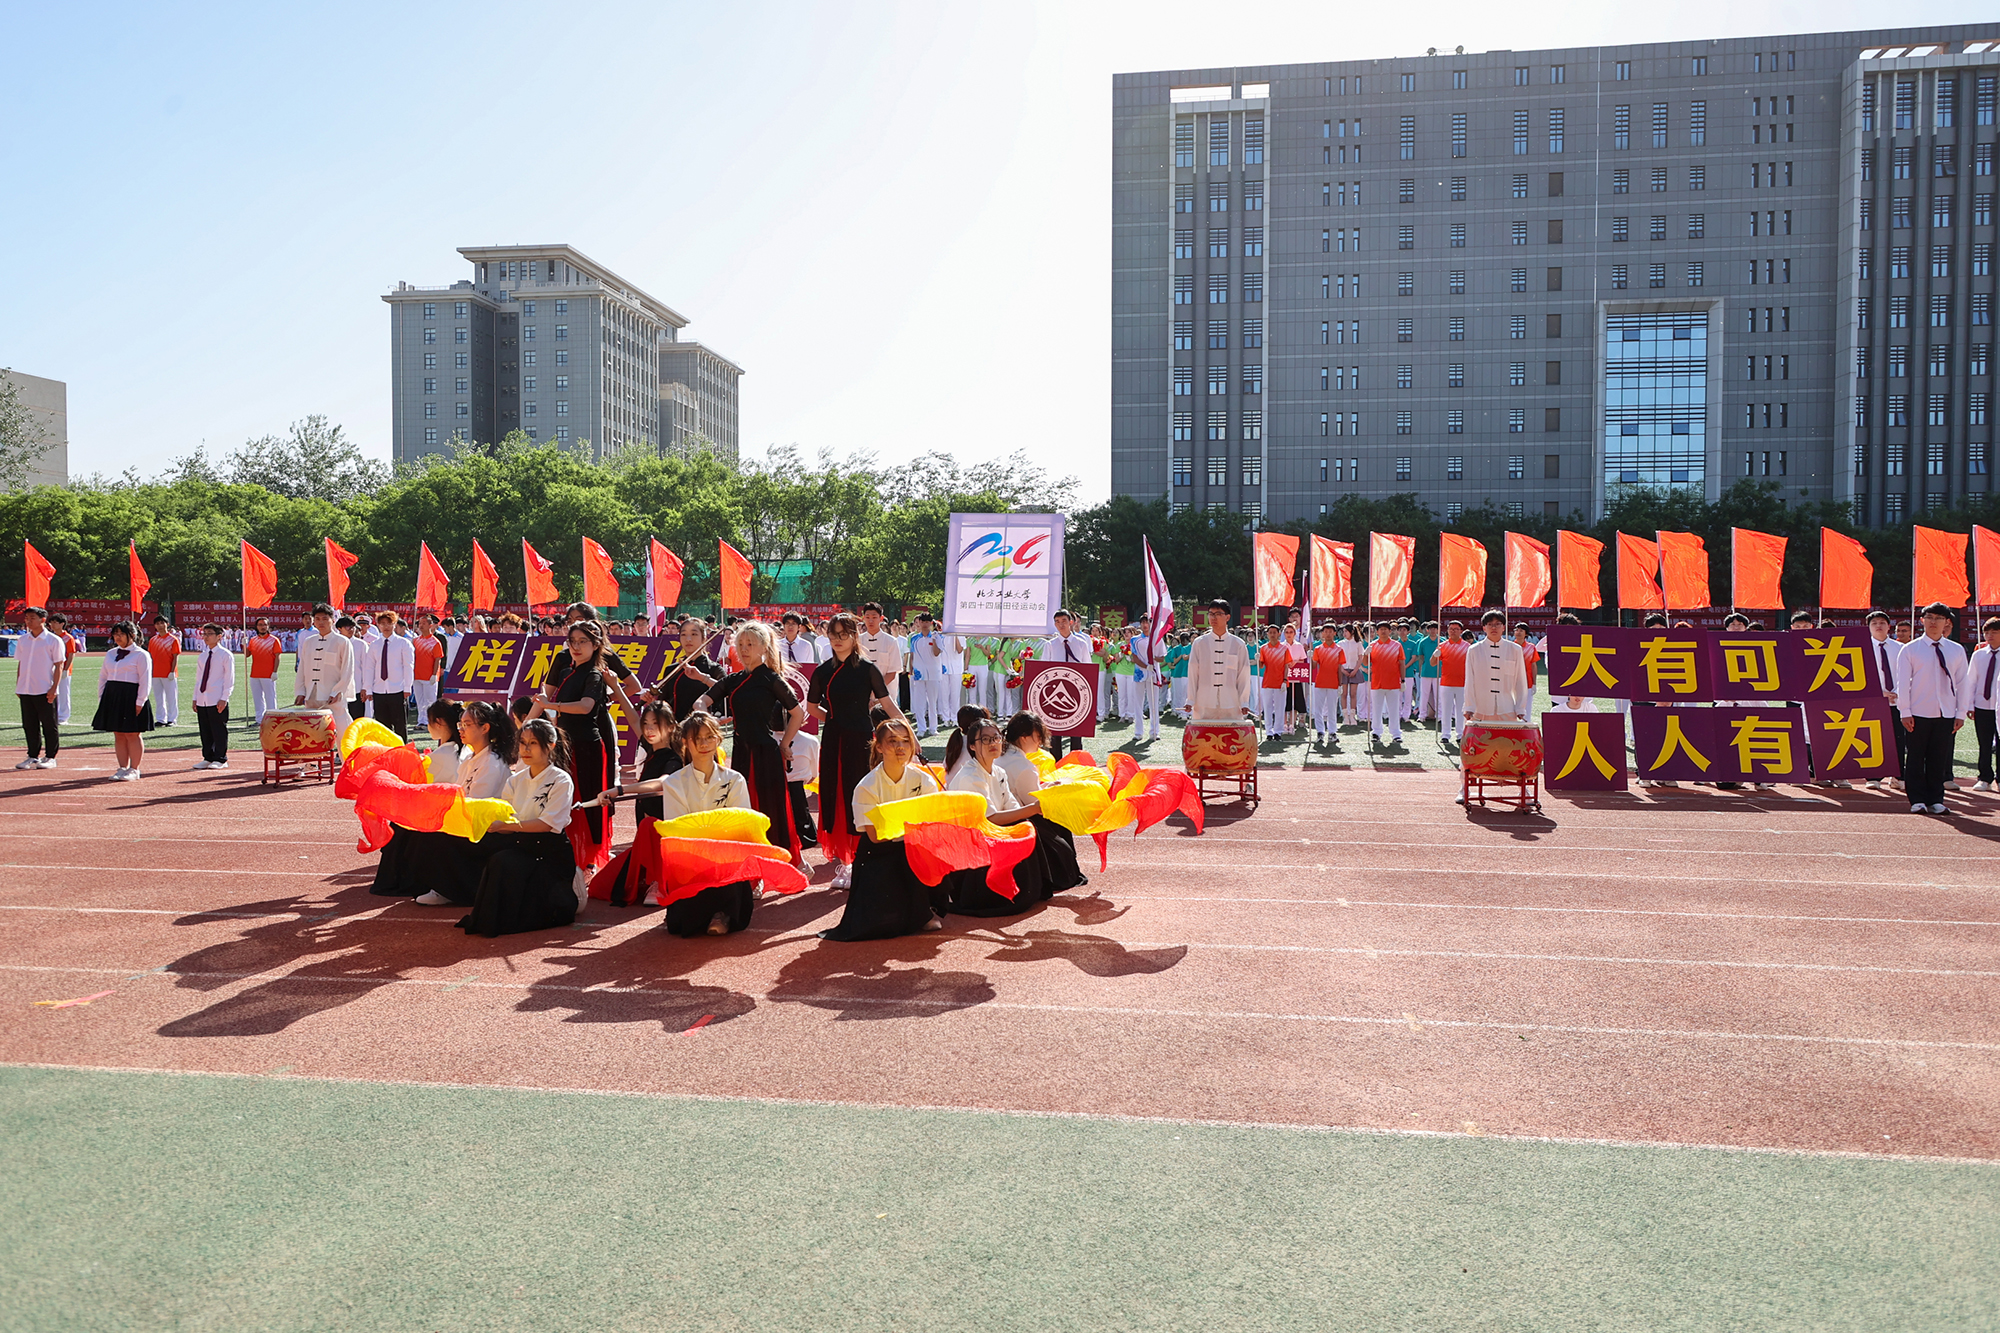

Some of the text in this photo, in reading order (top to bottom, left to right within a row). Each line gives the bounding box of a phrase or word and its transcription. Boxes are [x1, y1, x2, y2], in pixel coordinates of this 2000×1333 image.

[976, 588, 1031, 600] 北方工业大学
[959, 600, 1046, 611] 第四十四届田径运动会
[1102, 608, 1125, 628] 奋
[1243, 609, 1265, 627] 大
[1560, 634, 1867, 694] 大有可为
[1555, 707, 1885, 782] 人人有为
